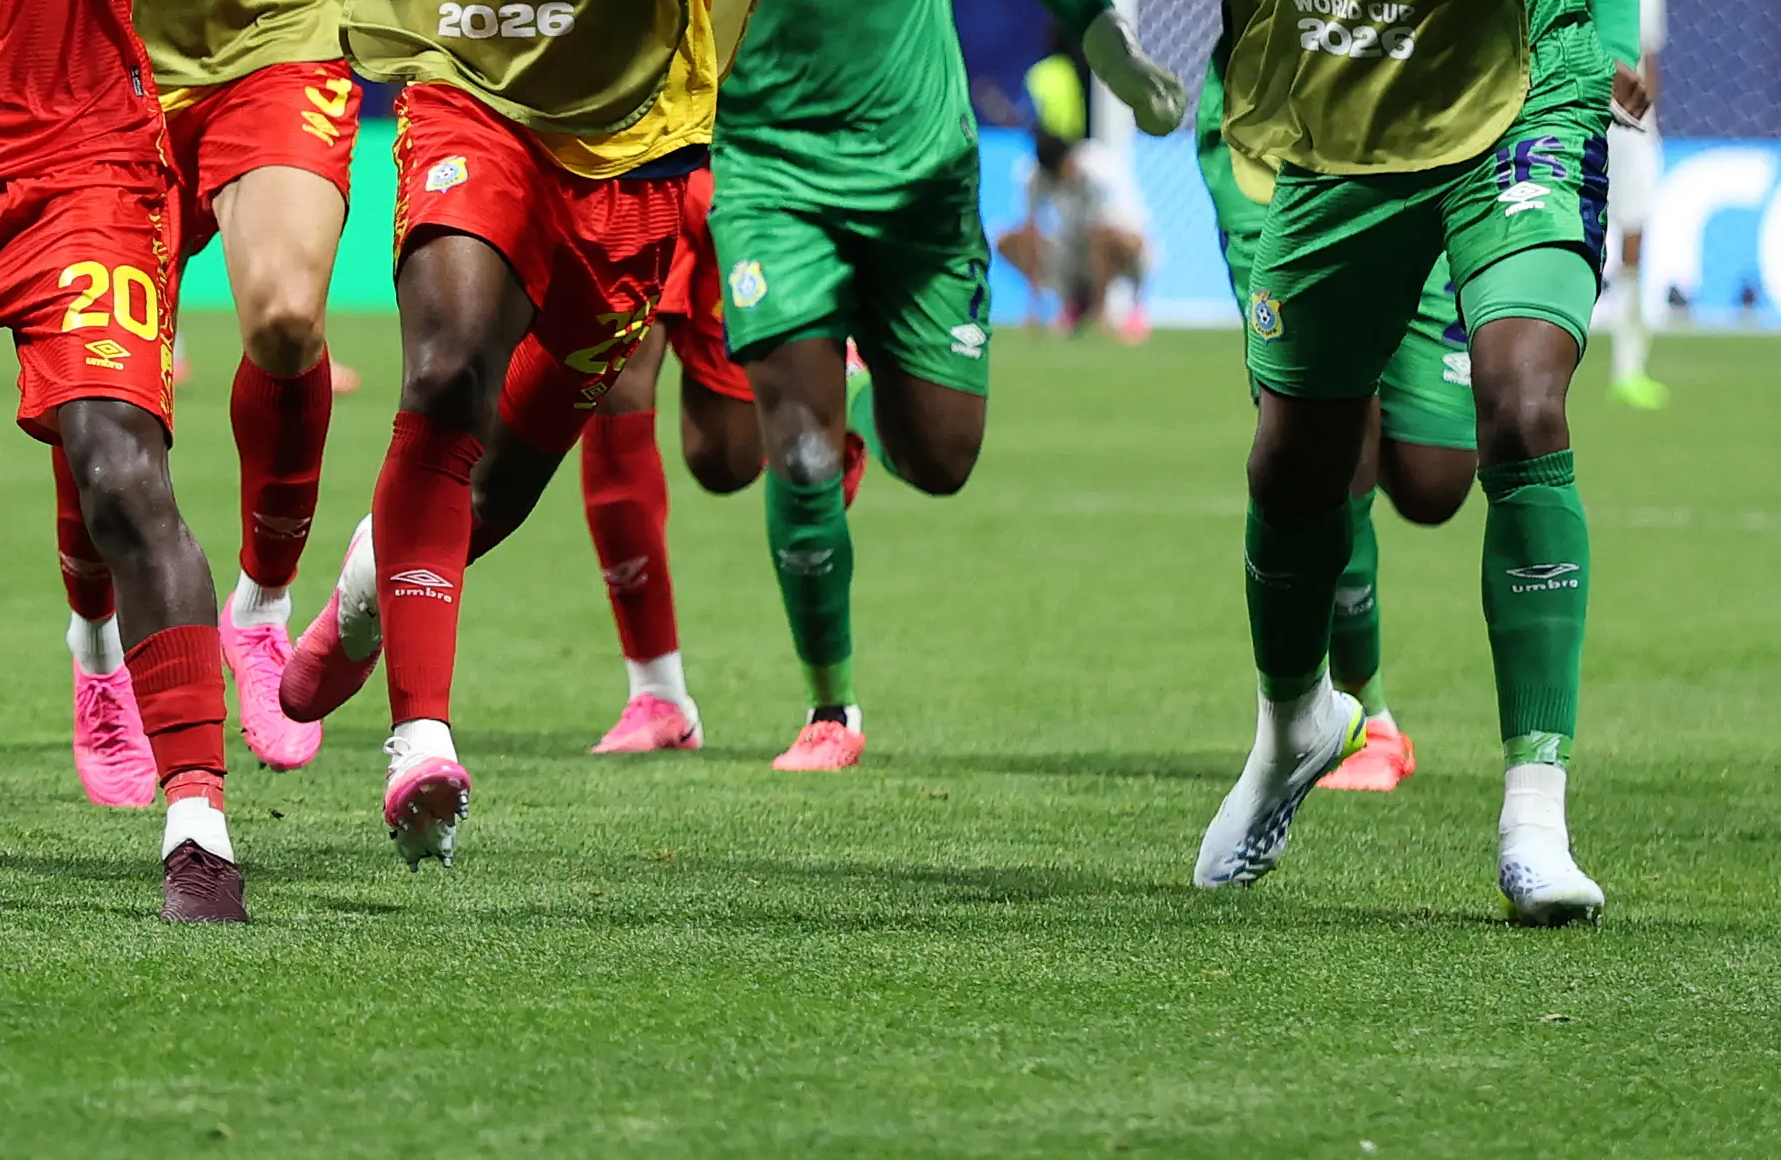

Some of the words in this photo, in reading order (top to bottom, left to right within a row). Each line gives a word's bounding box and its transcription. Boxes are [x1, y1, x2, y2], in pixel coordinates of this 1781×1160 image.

[437, 2, 575, 39] 2026
[1370, 2, 1415, 24] CUP
[1297, 18, 1416, 60] 2026
[1495, 136, 1567, 192] 16
[58, 260, 159, 341] 20
[85, 356, 125, 371] umbro
[394, 587, 453, 603] umbro
[1512, 580, 1578, 593] umbro
